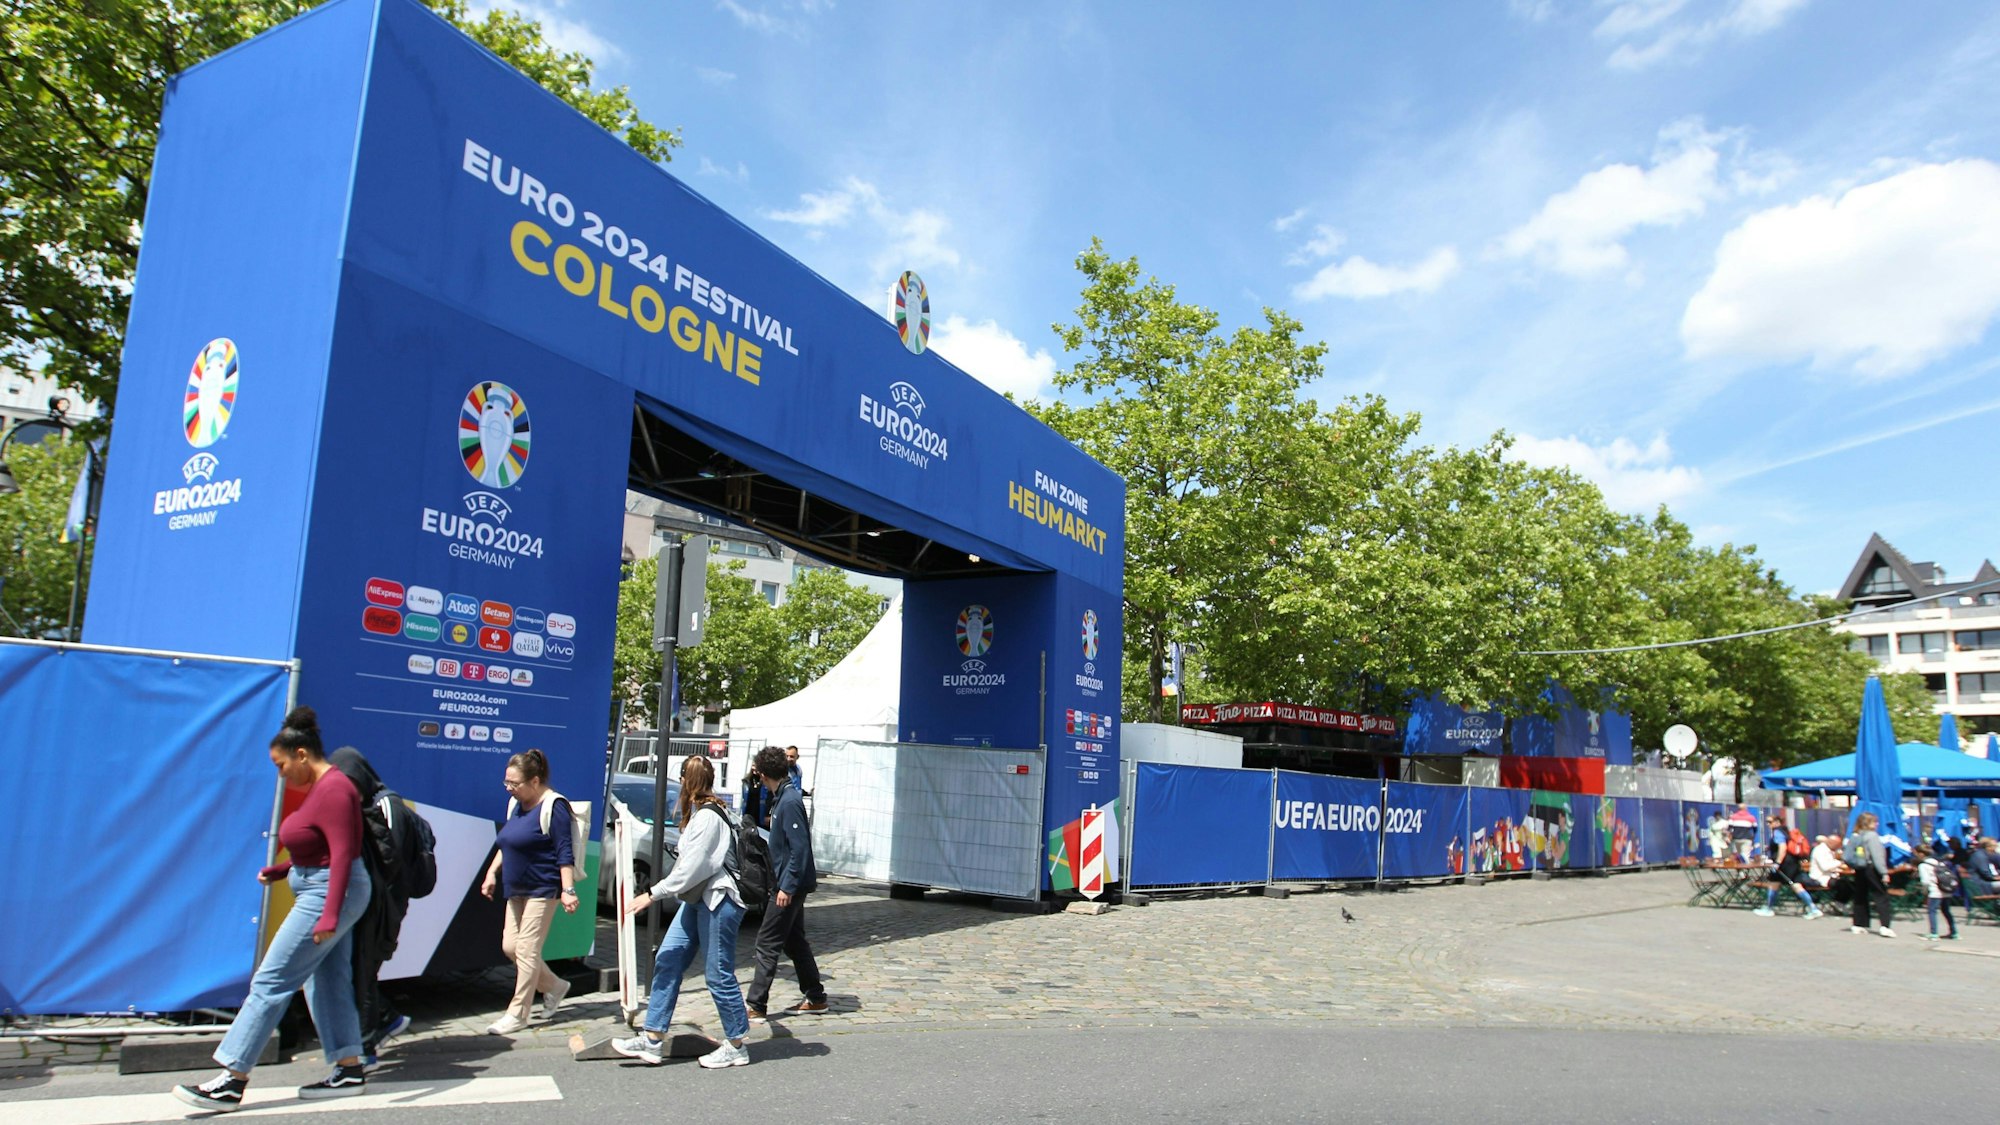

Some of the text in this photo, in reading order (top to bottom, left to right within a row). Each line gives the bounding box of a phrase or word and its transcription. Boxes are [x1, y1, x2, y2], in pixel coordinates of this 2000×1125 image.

[463, 138, 799, 356] EURO 2024 FESTIVAL
[510, 220, 763, 386] COLOGNE
[891, 386, 923, 417] UEFA
[860, 393, 948, 461] EURO2024
[879, 436, 929, 470] GERMANY
[183, 457, 216, 480] UEFA
[153, 477, 242, 515] EURO2024
[1035, 470, 1088, 515] FAN ZONE
[465, 496, 508, 521] UEFA
[1009, 480, 1106, 555] HEUMARKT
[168, 510, 218, 531] GERMANY
[422, 507, 544, 559] EURO2024
[448, 543, 516, 569] GERMANY
[368, 585, 403, 600] AliExpress
[484, 607, 510, 619] Betano
[406, 621, 439, 634] Hisense
[516, 642, 540, 653] QATAR
[546, 643, 574, 656] vivo
[441, 663, 455, 674] DB
[488, 669, 509, 680] ERGO
[962, 661, 985, 672] UEFA
[942, 674, 1006, 687] EURO2024
[955, 687, 991, 695] GERMANY
[432, 688, 508, 705] EURO2024.com
[438, 702, 500, 716] #EURO2024
[1182, 708, 1210, 719] PIZZA
[1243, 705, 1273, 718] PIZZA
[1277, 706, 1297, 719] PIZZA
[1299, 709, 1318, 722] PIZZA
[1320, 712, 1338, 724] PIZZA
[1340, 715, 1358, 727] PIZZA
[1379, 719, 1395, 731] PIZZA
[1386, 807, 1423, 833] 2024
